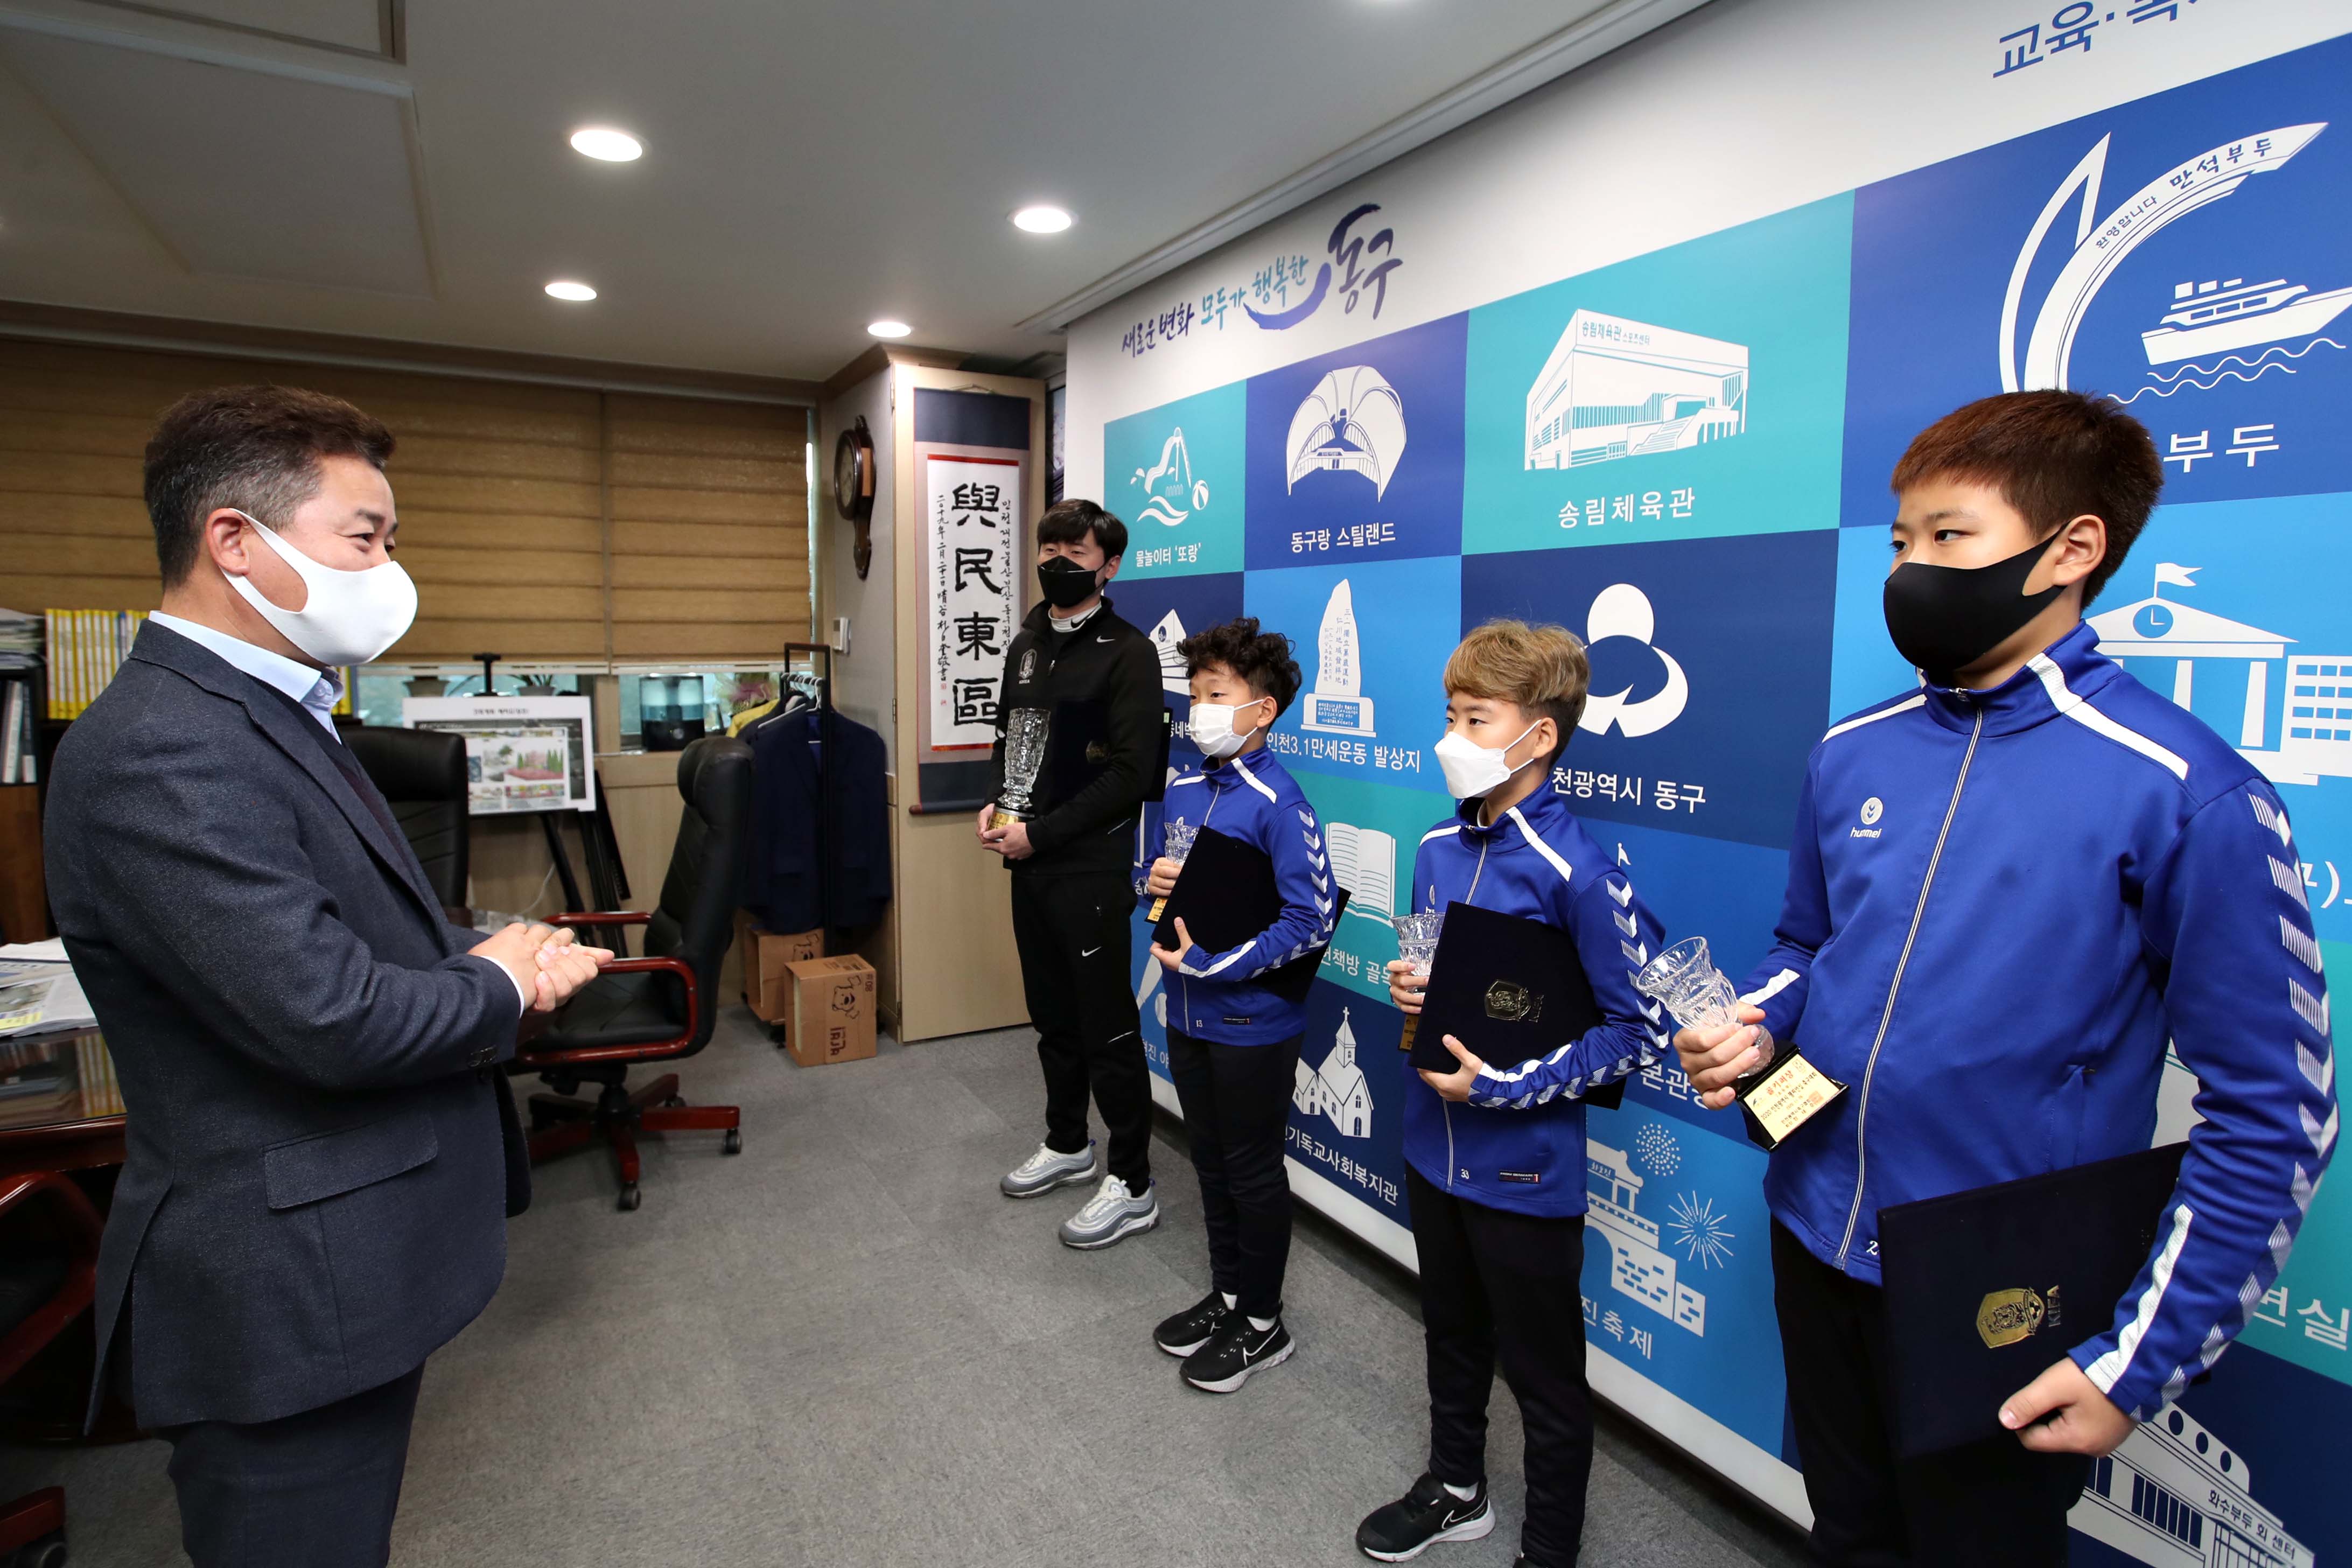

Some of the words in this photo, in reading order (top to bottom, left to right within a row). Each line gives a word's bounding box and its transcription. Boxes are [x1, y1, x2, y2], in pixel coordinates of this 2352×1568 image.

[1993, 0, 2198, 78] 교육·
[2169, 138, 2272, 190] 만석부두
[2096, 195, 2157, 249] 환영합니다
[1122, 319, 1156, 358] 새로운
[1159, 302, 1194, 340] 변화
[1201, 286, 1247, 331] 모두가
[1251, 255, 1309, 307] 행복한
[1558, 487, 1695, 529] 송림체육관
[1136, 547, 1172, 567] 물놀이터
[1291, 528, 1331, 553] 동구랑
[1336, 522, 1396, 547] 스틸랜드
[1266, 731, 1368, 765] 인천3.1만세운동
[1374, 745, 1421, 773] 발상지
[1654, 780, 1706, 813] 동구
[1850, 827, 1882, 838] hummel
[1195, 1019, 1203, 1028] 13
[1285, 1124, 1398, 1207] 기독교사회복지관
[1460, 1168, 1469, 1180] 33
[2208, 1489, 2253, 1529] 화수부두
[2272, 1535, 2295, 1560] 센터
